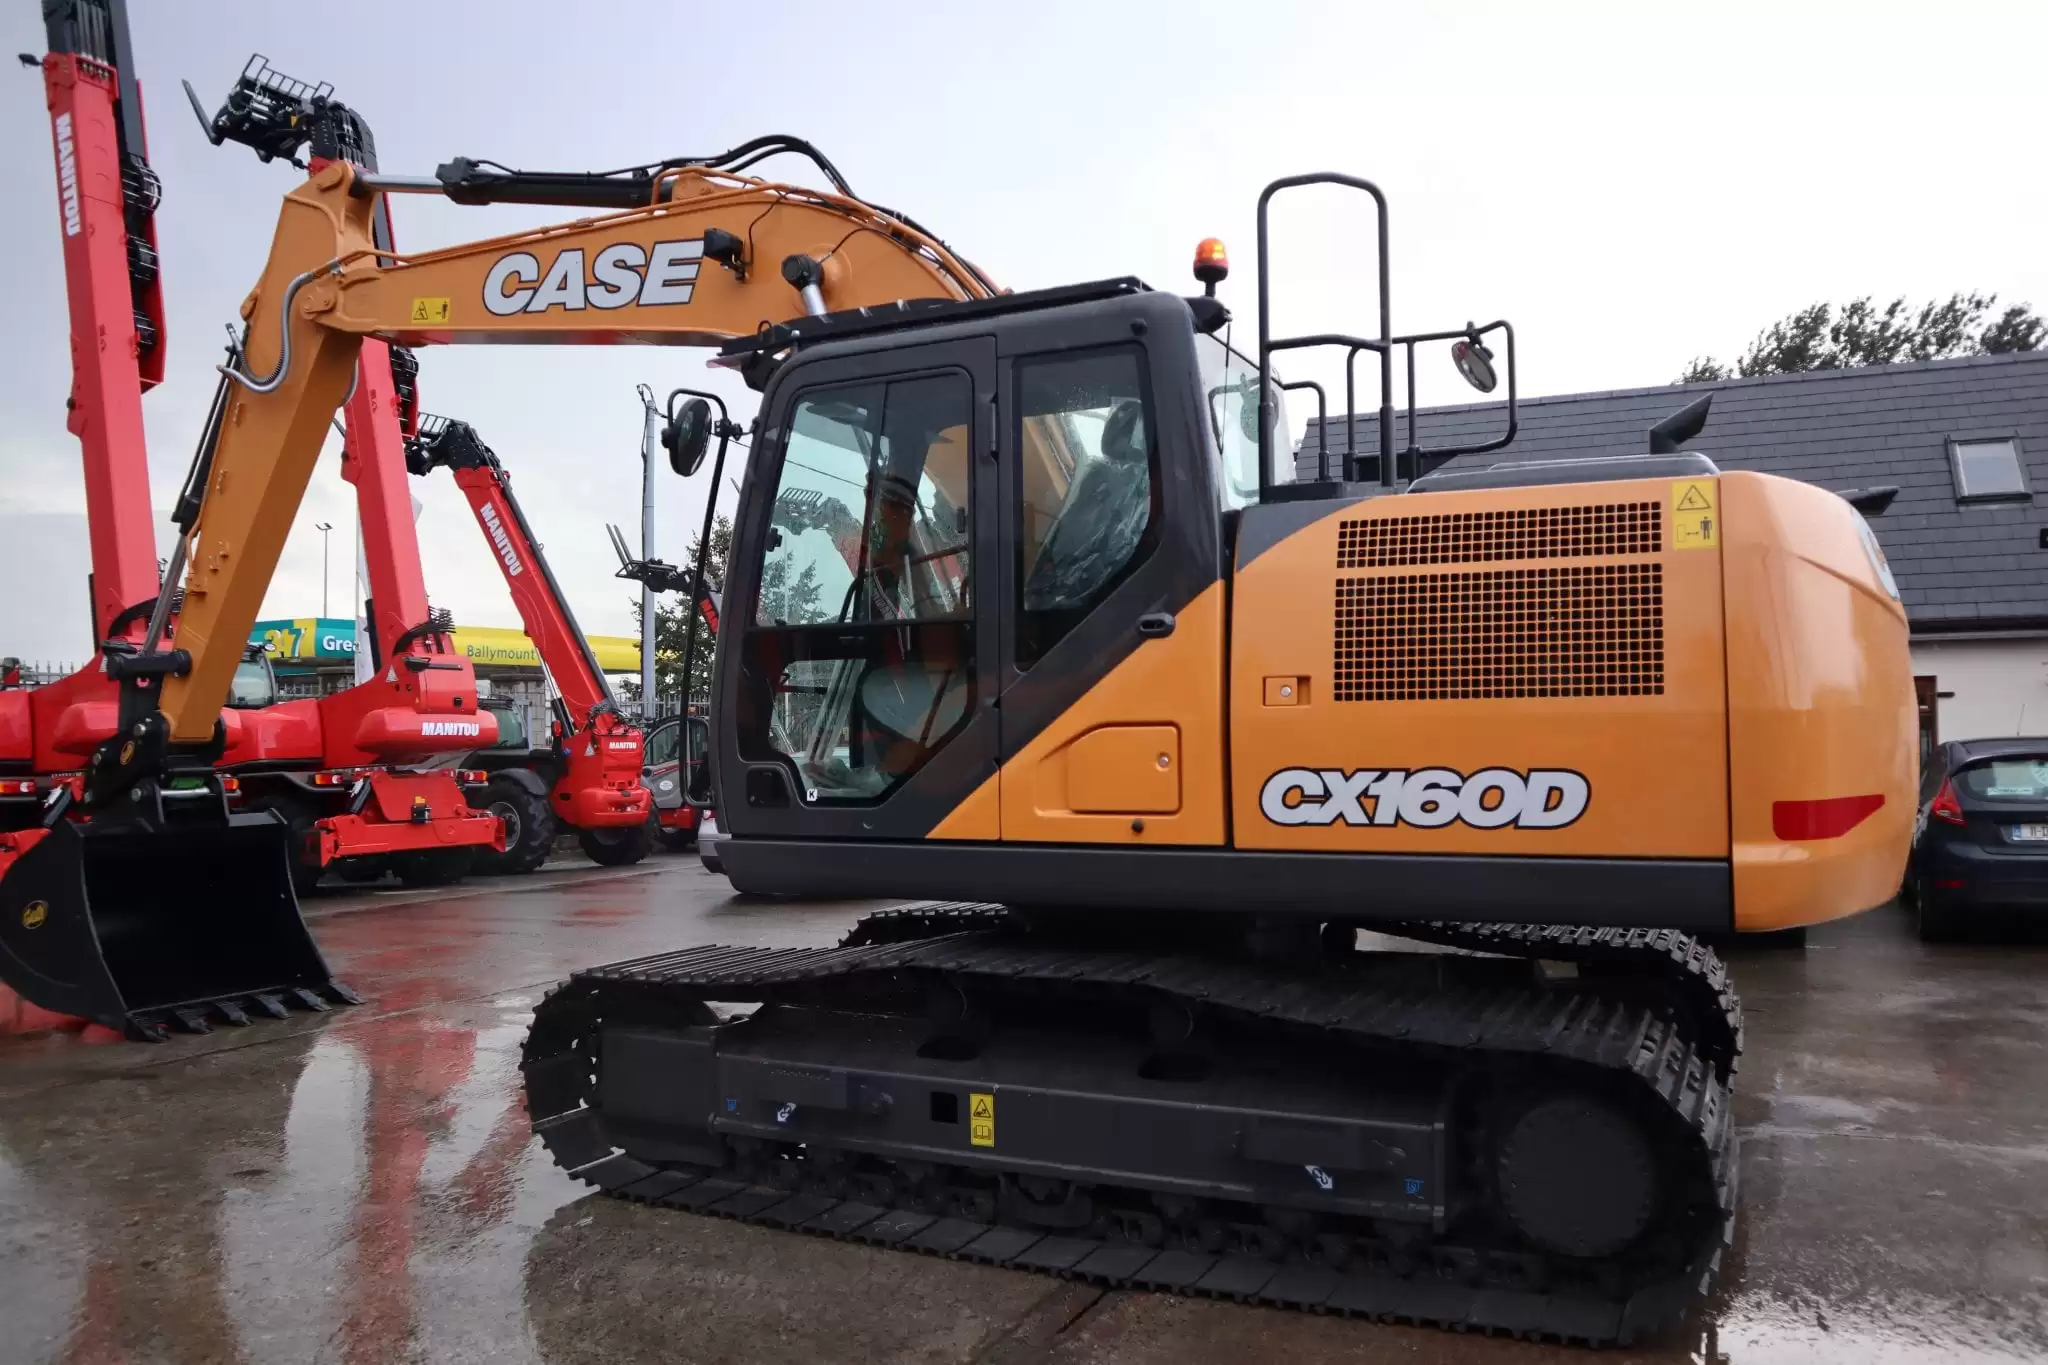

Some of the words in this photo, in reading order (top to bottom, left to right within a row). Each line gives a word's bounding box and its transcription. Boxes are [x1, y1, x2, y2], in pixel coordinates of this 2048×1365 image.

[56, 111, 82, 236] MANITOU
[482, 239, 704, 317] CASE
[480, 501, 523, 576] MANITOU
[467, 645, 536, 661] Ballymount
[422, 722, 480, 736] MANITOU
[1259, 766, 1592, 830] CX160D
